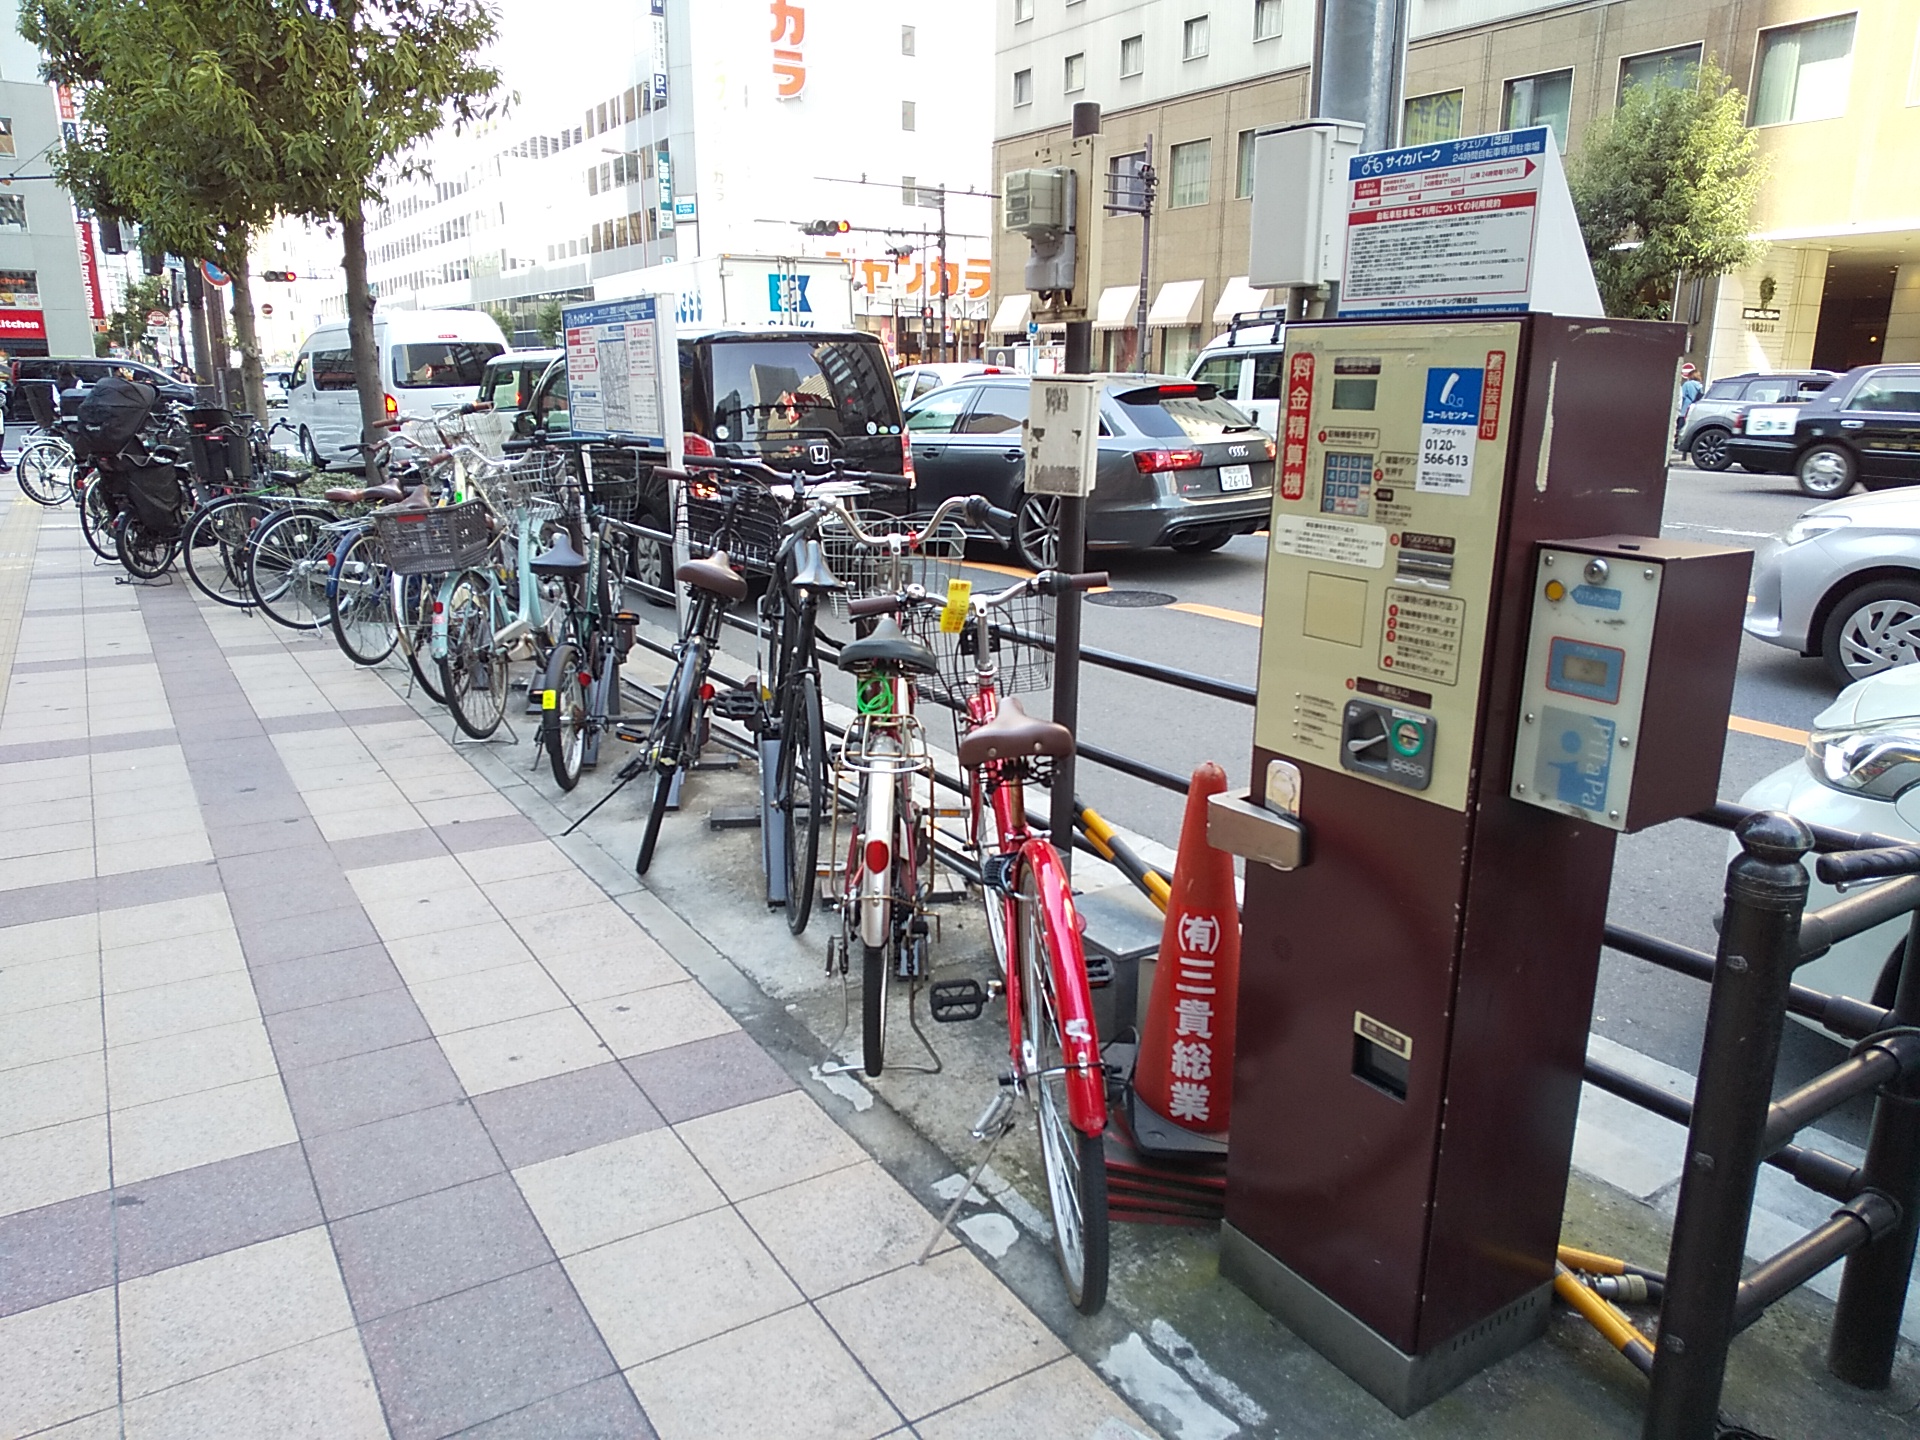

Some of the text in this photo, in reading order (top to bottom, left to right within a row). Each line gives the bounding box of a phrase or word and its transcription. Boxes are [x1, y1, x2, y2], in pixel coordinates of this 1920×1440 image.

[1386, 149, 1441, 168] サイカパーク
[1427, 410, 1475, 420] コールセンター
[1284, 356, 1314, 497] 料金精算機
[1432, 428, 1466, 436] フリーダイヤル
[1425, 438, 1456, 451] 0120-
[1424, 452, 1468, 467] 566-613
